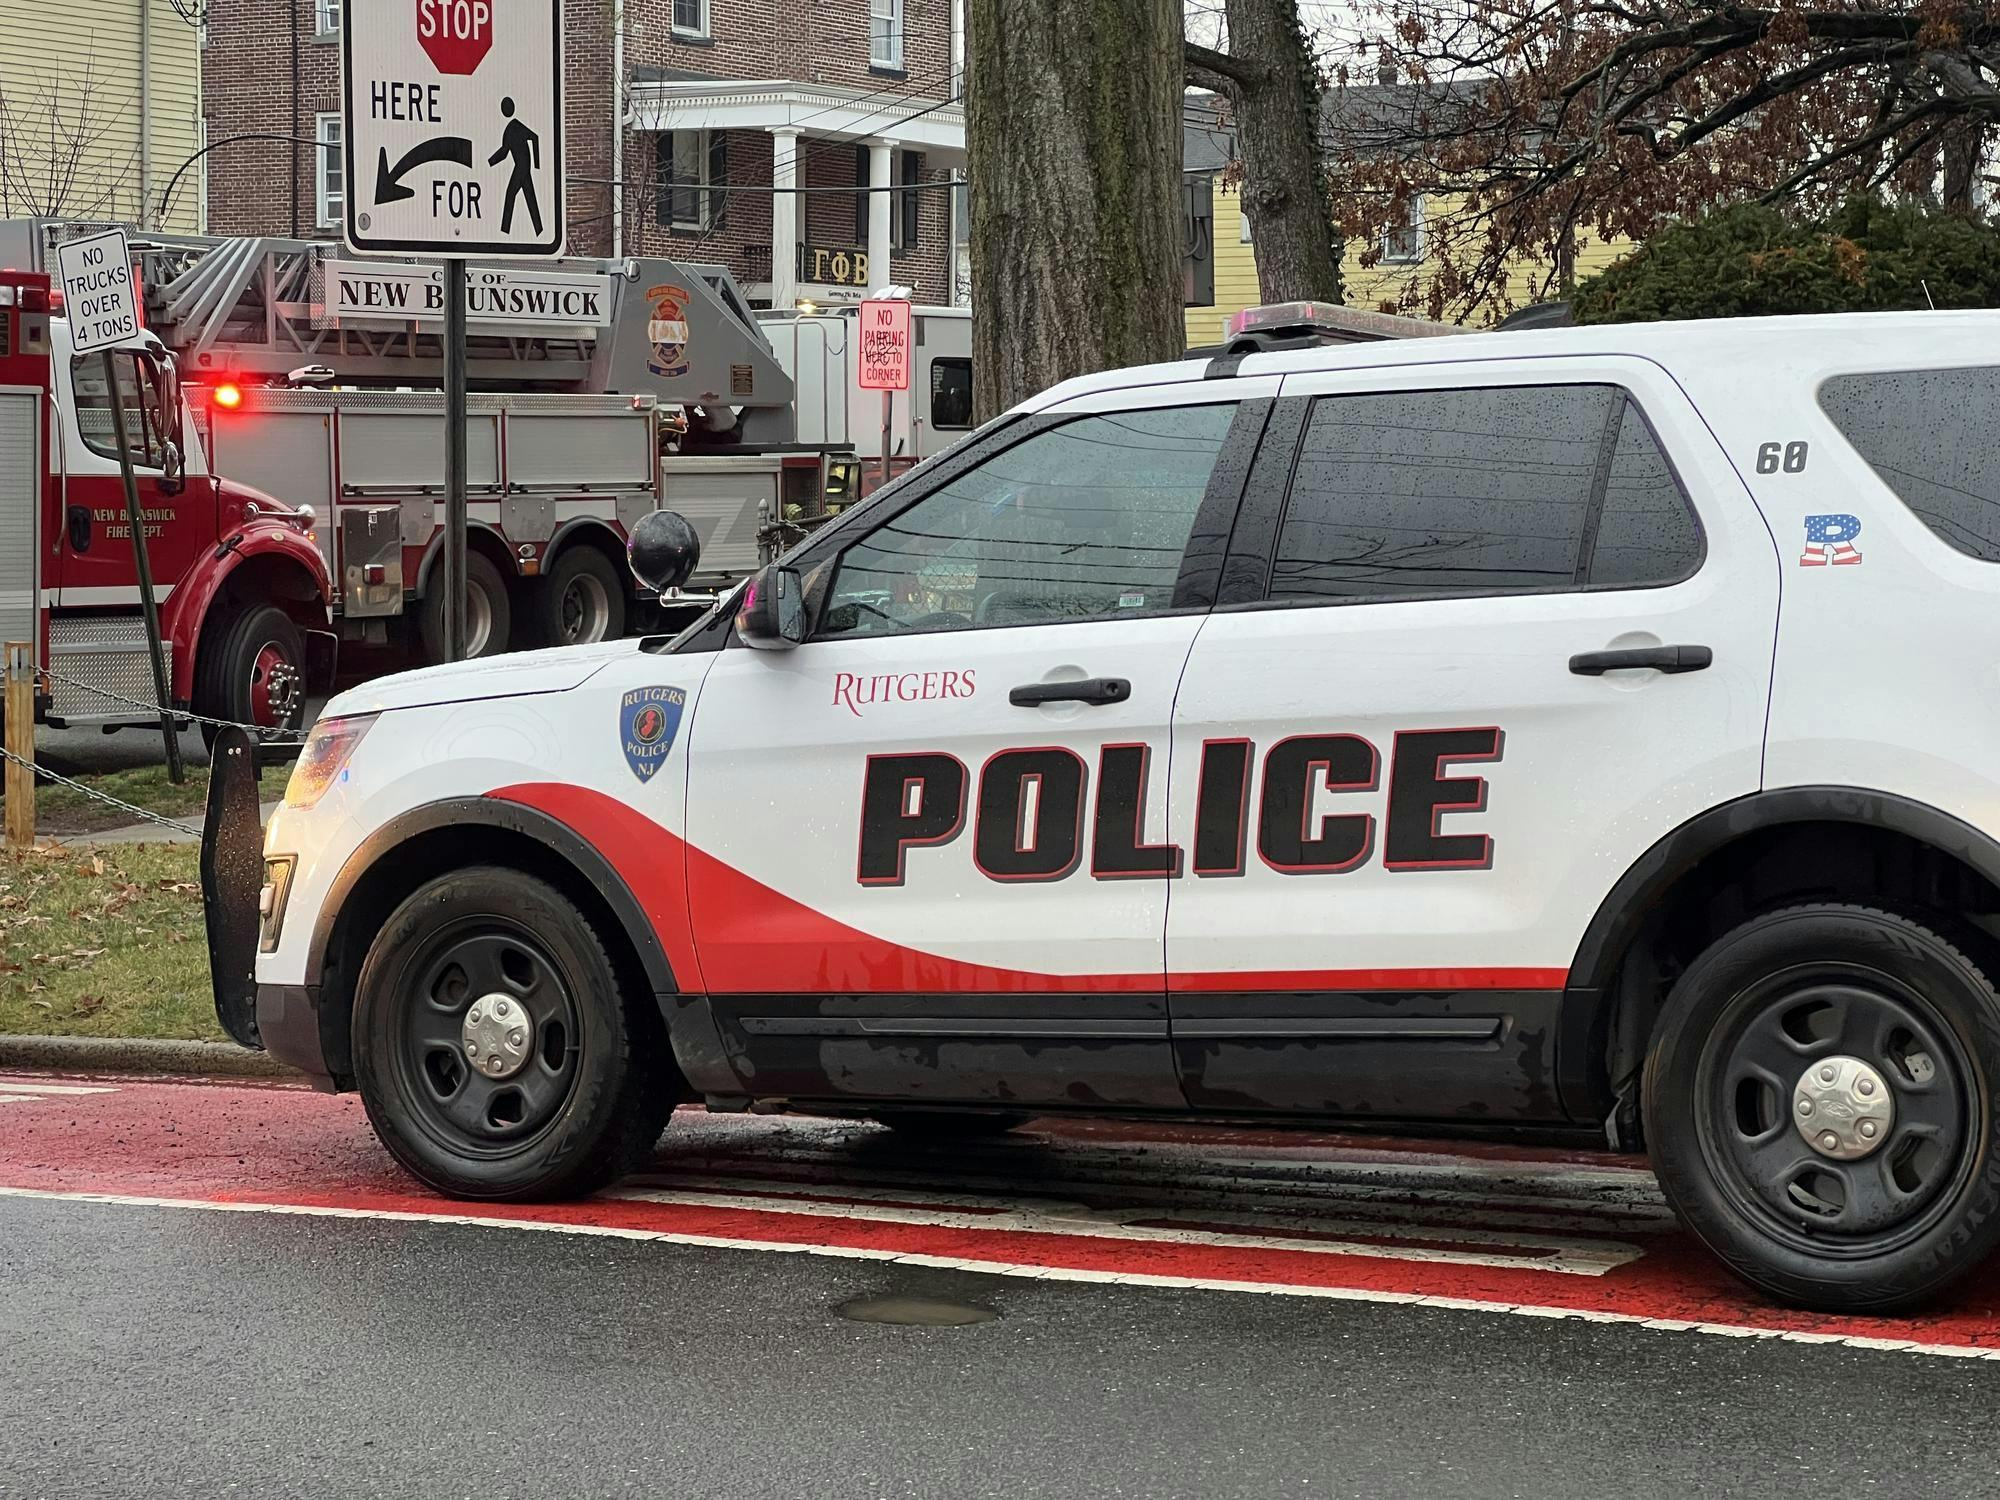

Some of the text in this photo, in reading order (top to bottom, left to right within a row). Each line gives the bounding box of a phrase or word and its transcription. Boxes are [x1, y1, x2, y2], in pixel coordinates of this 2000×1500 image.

[420, 0, 489, 40] STOP
[371, 80, 442, 123] HERE
[432, 180, 482, 219] FOR
[82, 247, 104, 268] NO
[67, 266, 127, 296] TRUCKS
[431, 271, 507, 285] CY OF
[81, 293, 121, 318] OVER
[338, 279, 600, 316] NEW BUNSWICK
[77, 315, 133, 342] 4 TONS
[877, 309, 893, 326] NO
[892, 352, 903, 365] TO
[866, 368, 901, 381] CORNER
[1756, 441, 1809, 475] 60
[93, 508, 176, 521] NEW BNSWICK
[106, 525, 164, 538] FIRE EPT.
[1800, 514, 1862, 566] R
[624, 688, 685, 707] RUTGERS
[831, 669, 976, 718] RUTGERS
[627, 740, 668, 757] POLICE
[638, 763, 654, 776] NJ
[856, 726, 1506, 887] POLICE
